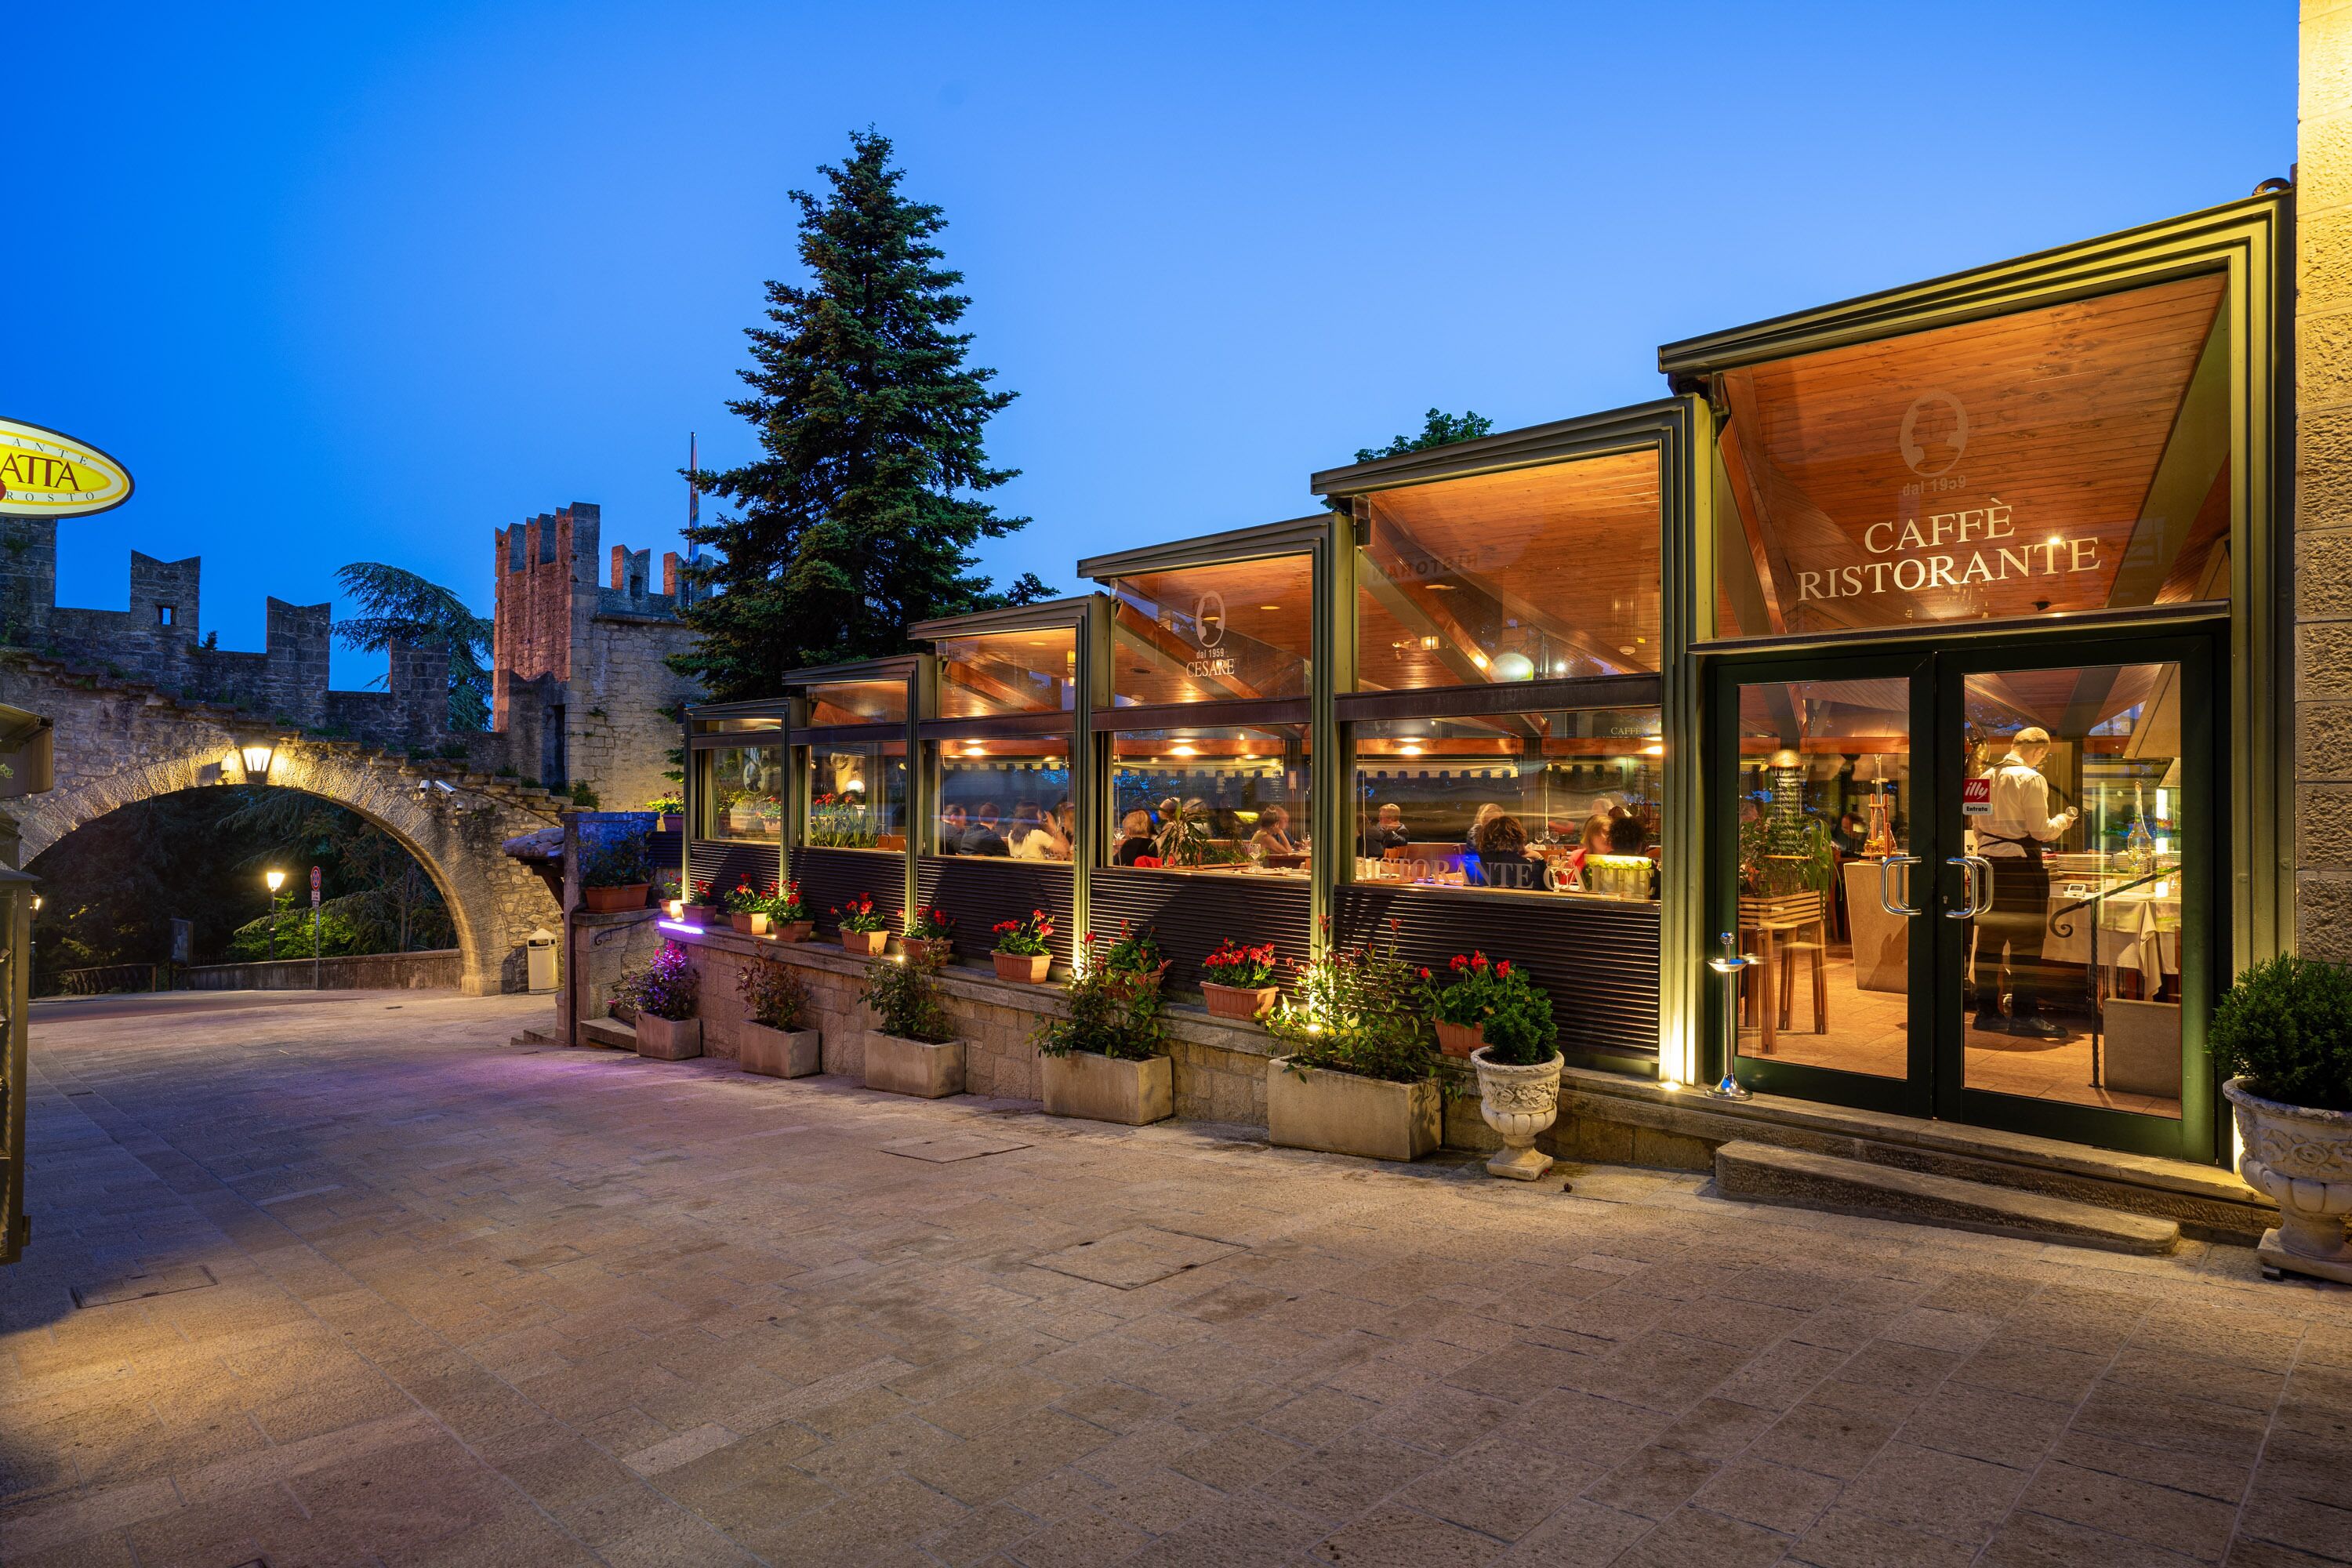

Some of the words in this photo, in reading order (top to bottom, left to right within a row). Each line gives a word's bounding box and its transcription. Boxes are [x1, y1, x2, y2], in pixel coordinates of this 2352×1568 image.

[1903, 481, 1924, 495] dal
[1865, 498, 2016, 554] CAFFÈ
[1798, 536, 2101, 601] RISTORANTE
[1196, 650, 1206, 659] dal
[1208, 648, 1224, 658] 1959
[1186, 659, 1234, 677] CESARE
[1965, 782, 1988, 800] illy
[1356, 857, 1533, 888] RISTORANTE
